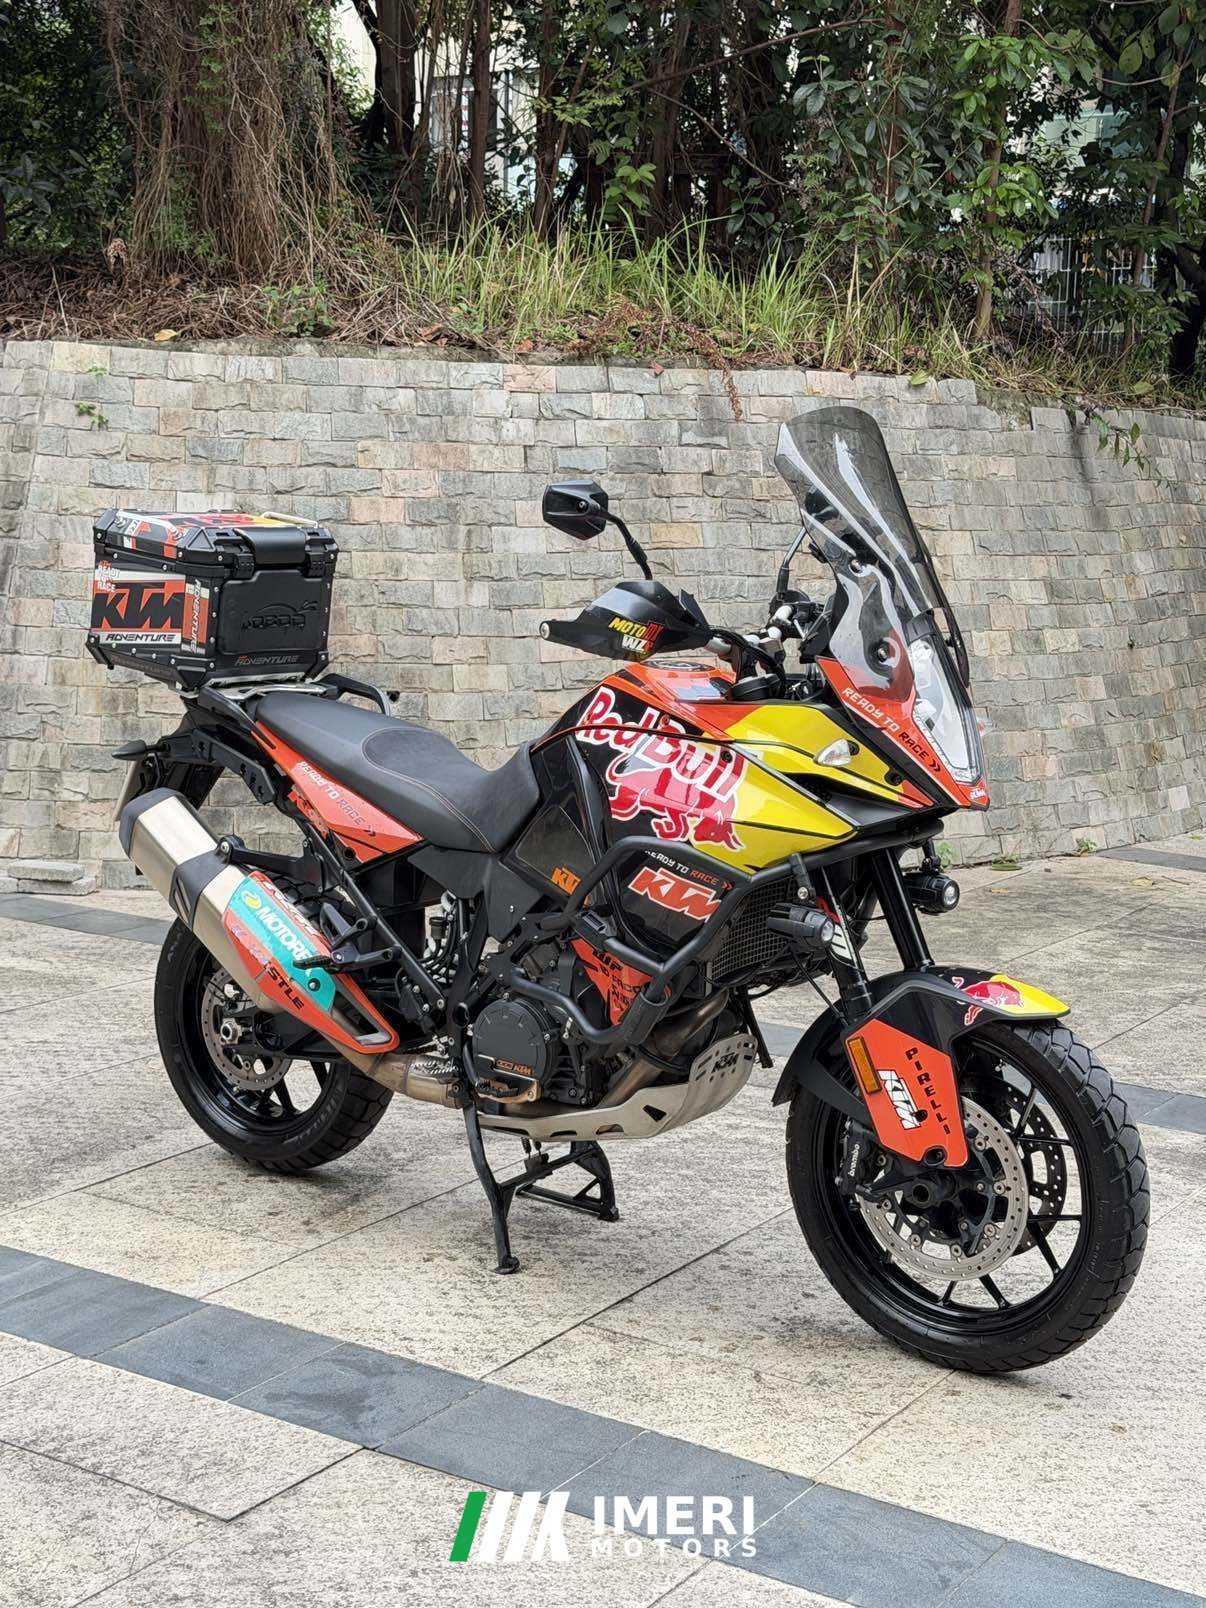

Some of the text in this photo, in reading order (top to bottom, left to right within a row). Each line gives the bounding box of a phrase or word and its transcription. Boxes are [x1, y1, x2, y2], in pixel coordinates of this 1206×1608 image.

[91, 584, 184, 629] KTM
[190, 579, 202, 653] ADVENTURE
[105, 633, 176, 642] ADVENTURE
[234, 655, 300, 666] ADVENTURE
[842, 687, 930, 761] READY TO RACE
[296, 761, 328, 787] READY
[326, 783, 340, 800] TO
[337, 799, 366, 825] RACE
[628, 866, 722, 923] KTM
[676, 863, 689, 874] TO
[690, 869, 719, 885] RACE
[876, 1070, 921, 1130] KTM
[847, 1143, 861, 1177] brembo
